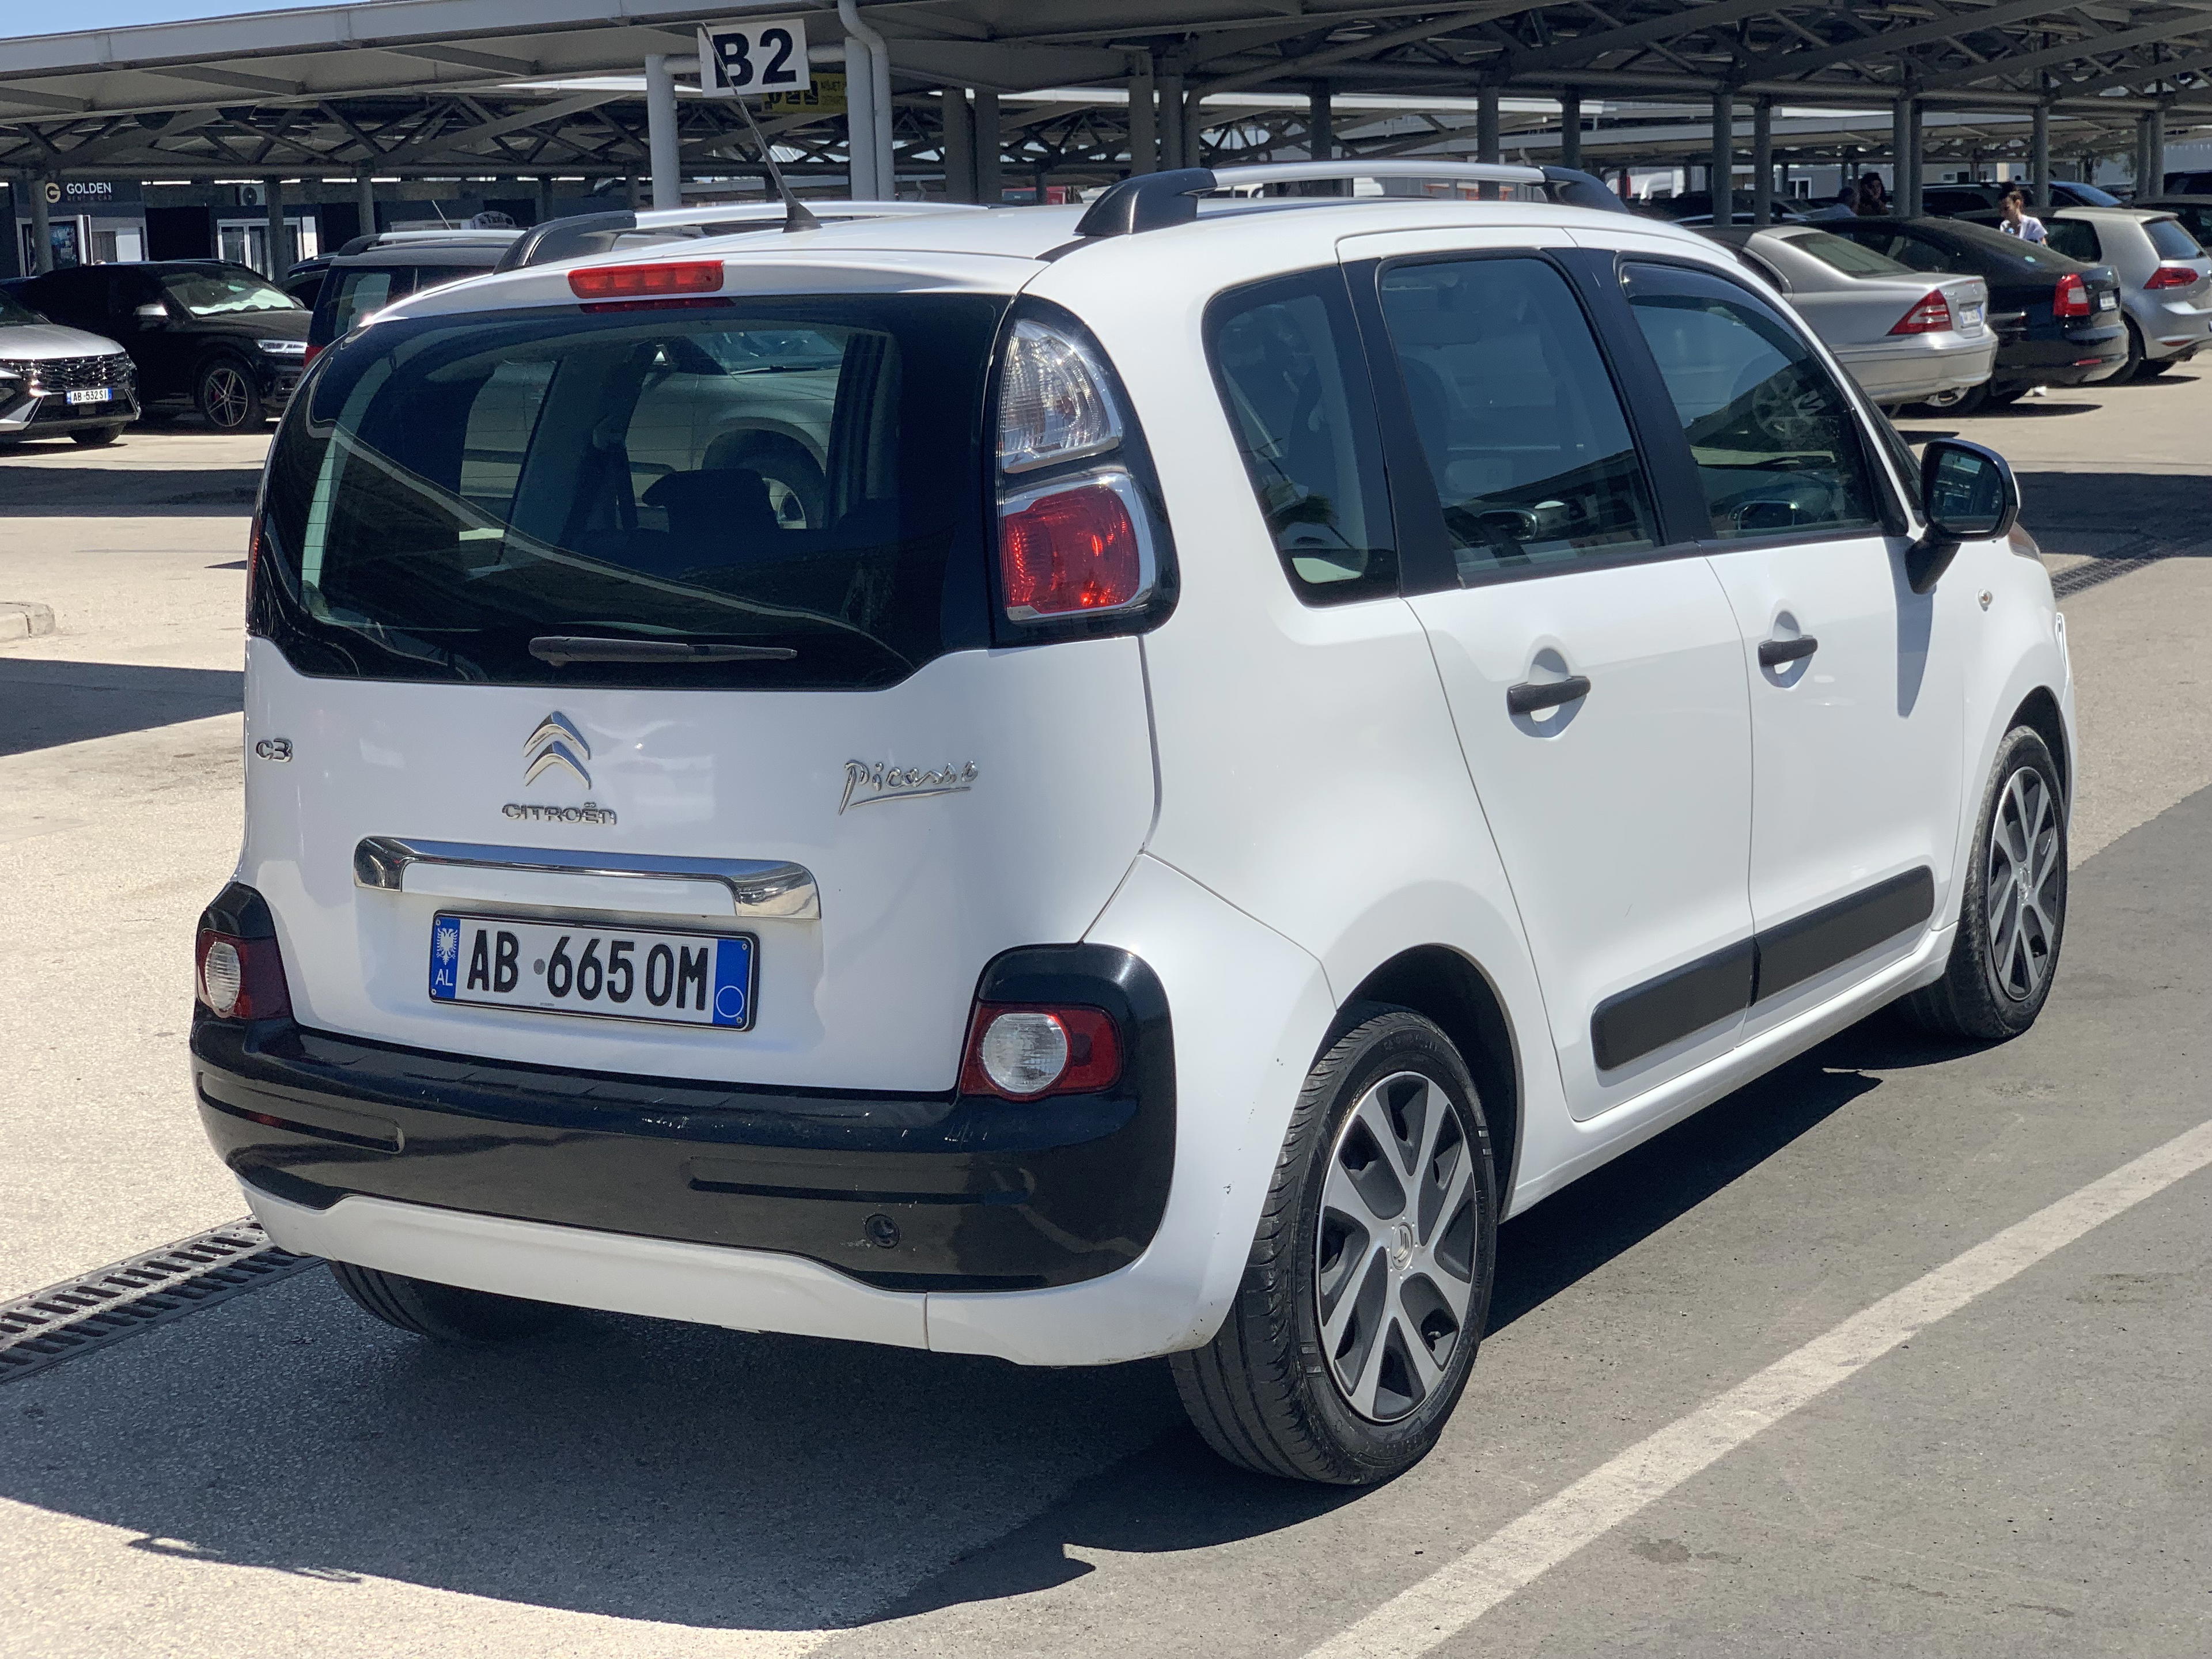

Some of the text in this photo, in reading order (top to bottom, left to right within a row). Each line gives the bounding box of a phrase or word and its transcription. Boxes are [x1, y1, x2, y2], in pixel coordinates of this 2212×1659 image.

[712, 28, 797, 88] B2
[67, 182, 112, 194] GOLDEN
[73, 389, 107, 402] AB 532 SI
[256, 737, 293, 762] C3
[839, 759, 979, 816] Picasso
[435, 968, 454, 986] AL
[467, 929, 519, 993] AB
[547, 935, 635, 1003] 665
